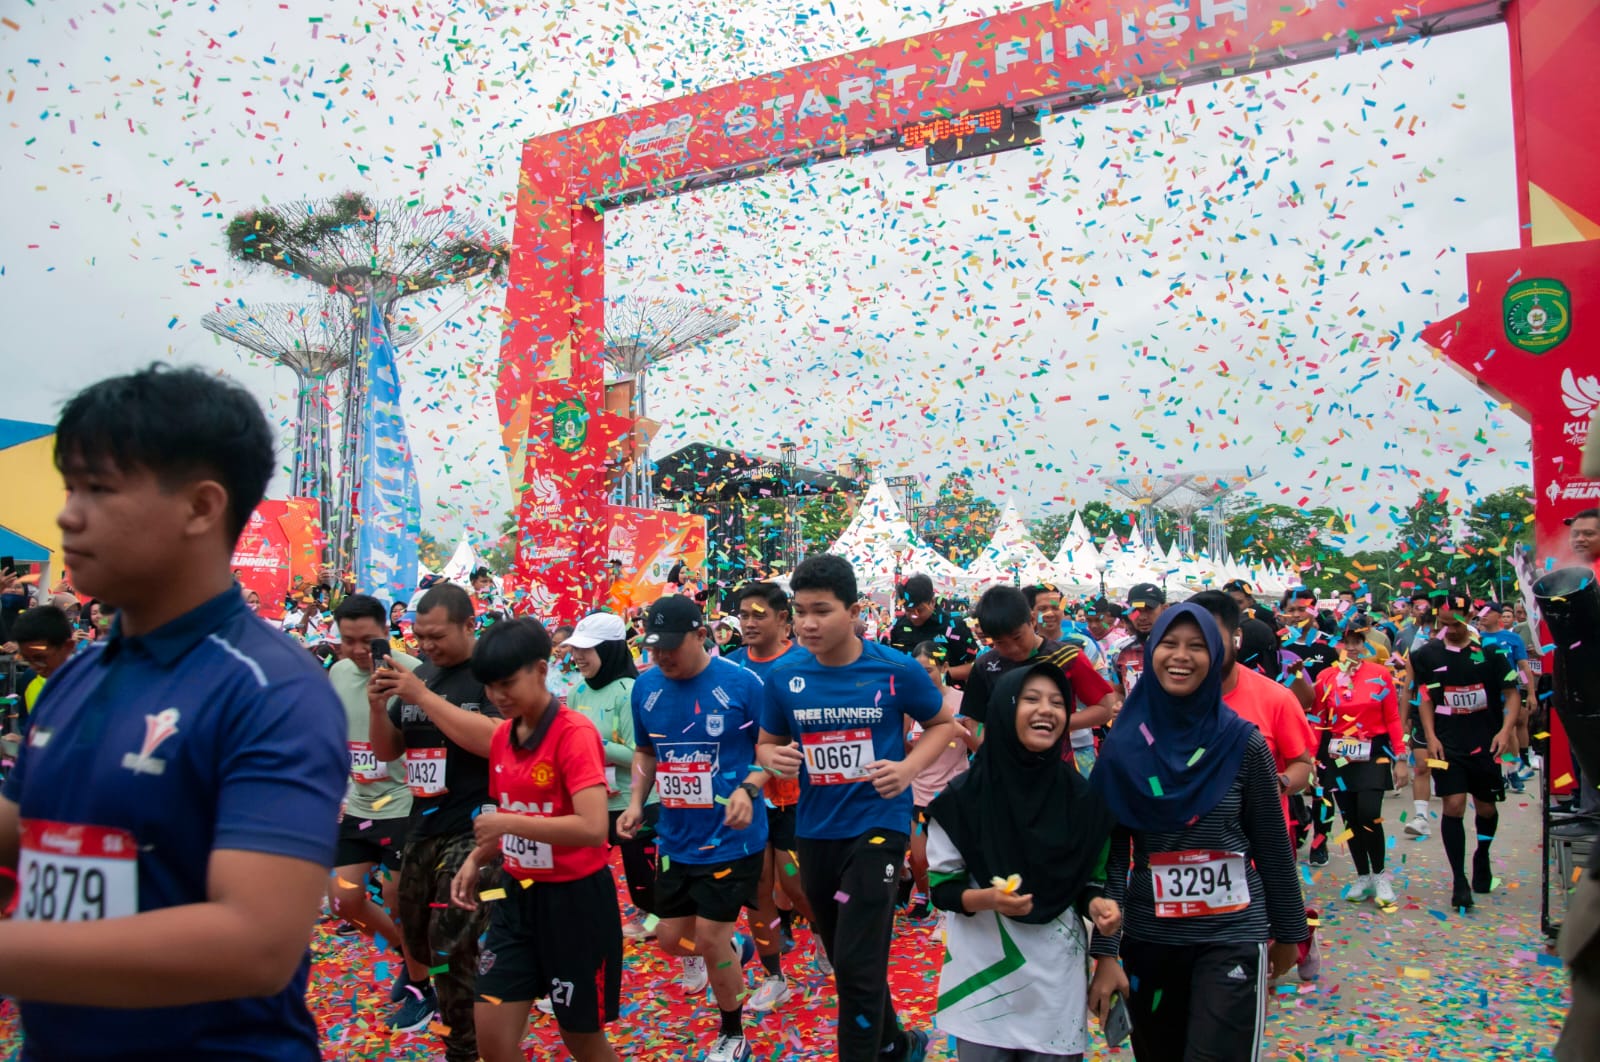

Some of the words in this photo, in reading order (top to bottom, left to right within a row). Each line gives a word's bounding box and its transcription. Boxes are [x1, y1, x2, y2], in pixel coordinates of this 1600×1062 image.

[723, 64, 917, 137] START
[994, 0, 1248, 75] FINISH
[1452, 692, 1477, 707] 0117
[793, 708, 823, 721] FREE
[823, 707, 884, 719] RUNNERS
[814, 744, 862, 770] 0667
[408, 762, 437, 783] 0432
[664, 775, 702, 796] 3939
[24, 860, 106, 921] 3879
[1167, 862, 1232, 897] 3294
[551, 977, 575, 1008] 27
